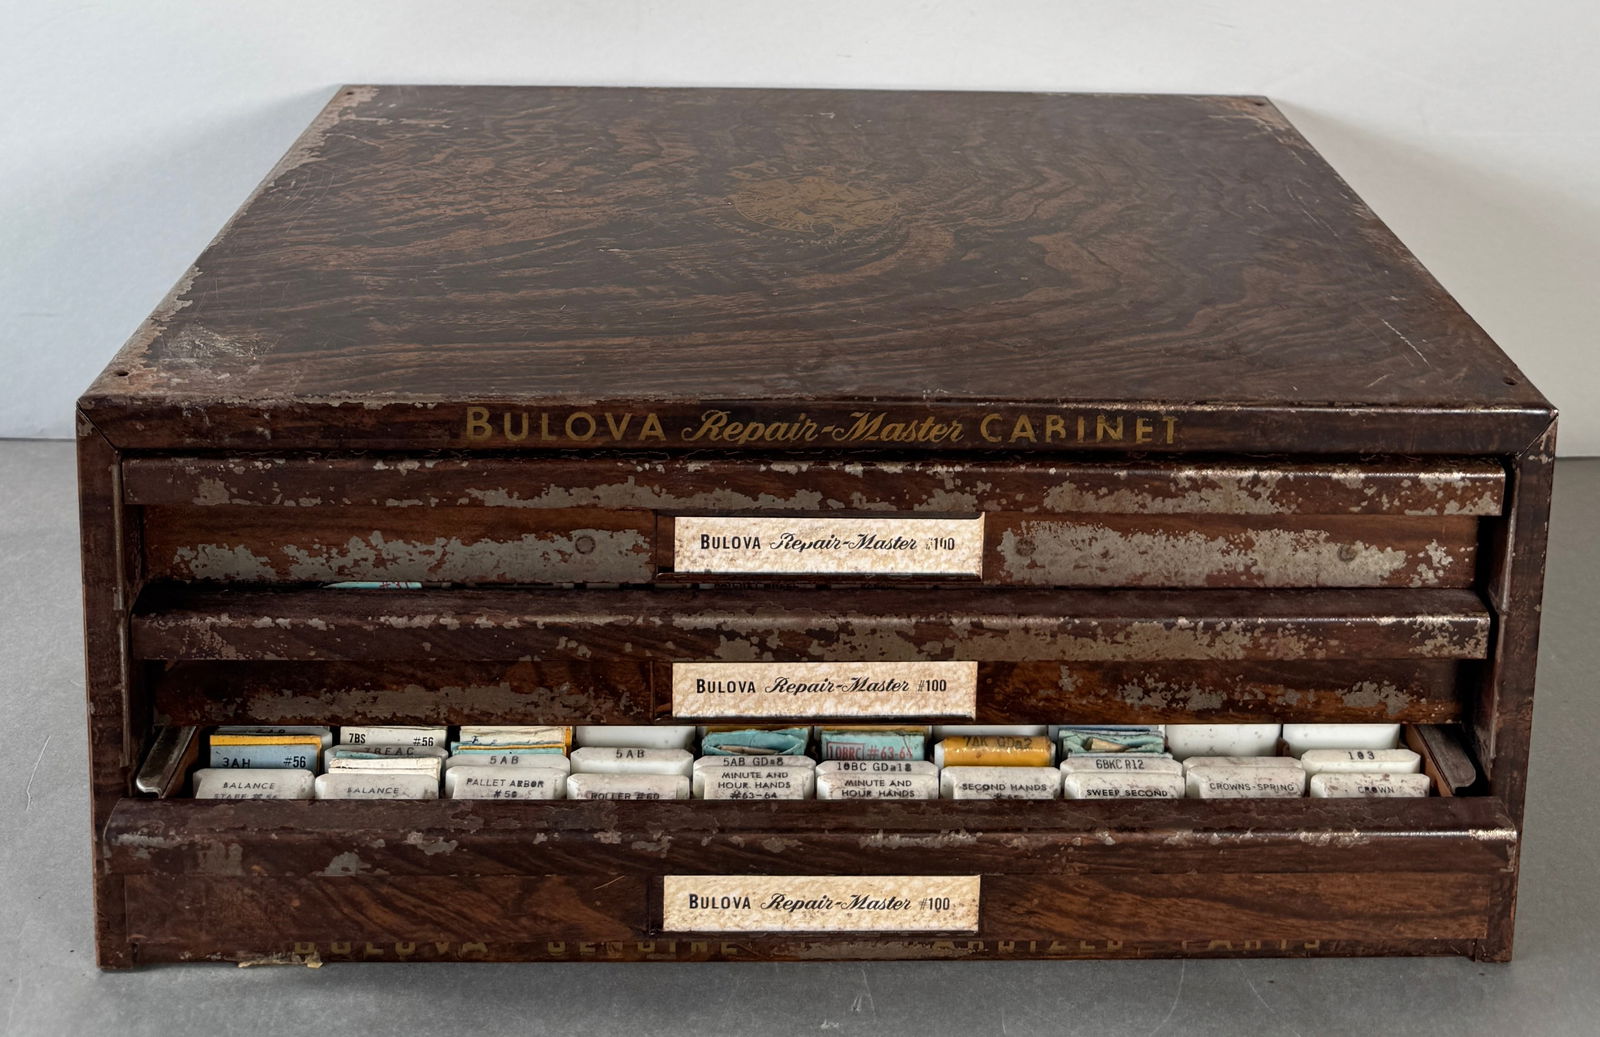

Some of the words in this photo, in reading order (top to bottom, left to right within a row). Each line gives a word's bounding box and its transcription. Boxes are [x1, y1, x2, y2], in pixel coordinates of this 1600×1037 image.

[466, 406, 667, 442] BULOVA
[681, 409, 965, 445] Repair-Master
[700, 533, 761, 550] BULOVA
[769, 532, 918, 553] Repair-Master
[696, 678, 756, 694] BULOVA
[764, 676, 910, 697] Repair-Master
[917, 679, 948, 693] #100
[349, 733, 366, 744] 7BS
[413, 737, 434, 747] #56
[283, 755, 306, 768] #56
[721, 771, 762, 779] MINUTE
[223, 782, 276, 790] BALANCE
[466, 778, 506, 787] PALLET
[755, 781, 791, 789] HANDS
[844, 779, 885, 787] MINUTE
[962, 783, 1006, 791] SECOND
[1010, 783, 1048, 791] HANDS
[841, 789, 872, 798] HOUR
[878, 789, 915, 798] HANDS
[1087, 789, 1120, 797] SWEEP
[1125, 789, 1168, 797] SECOND
[688, 893, 752, 909] BULOVA
[760, 892, 912, 913] Repair-Master
[918, 897, 951, 911] #100
